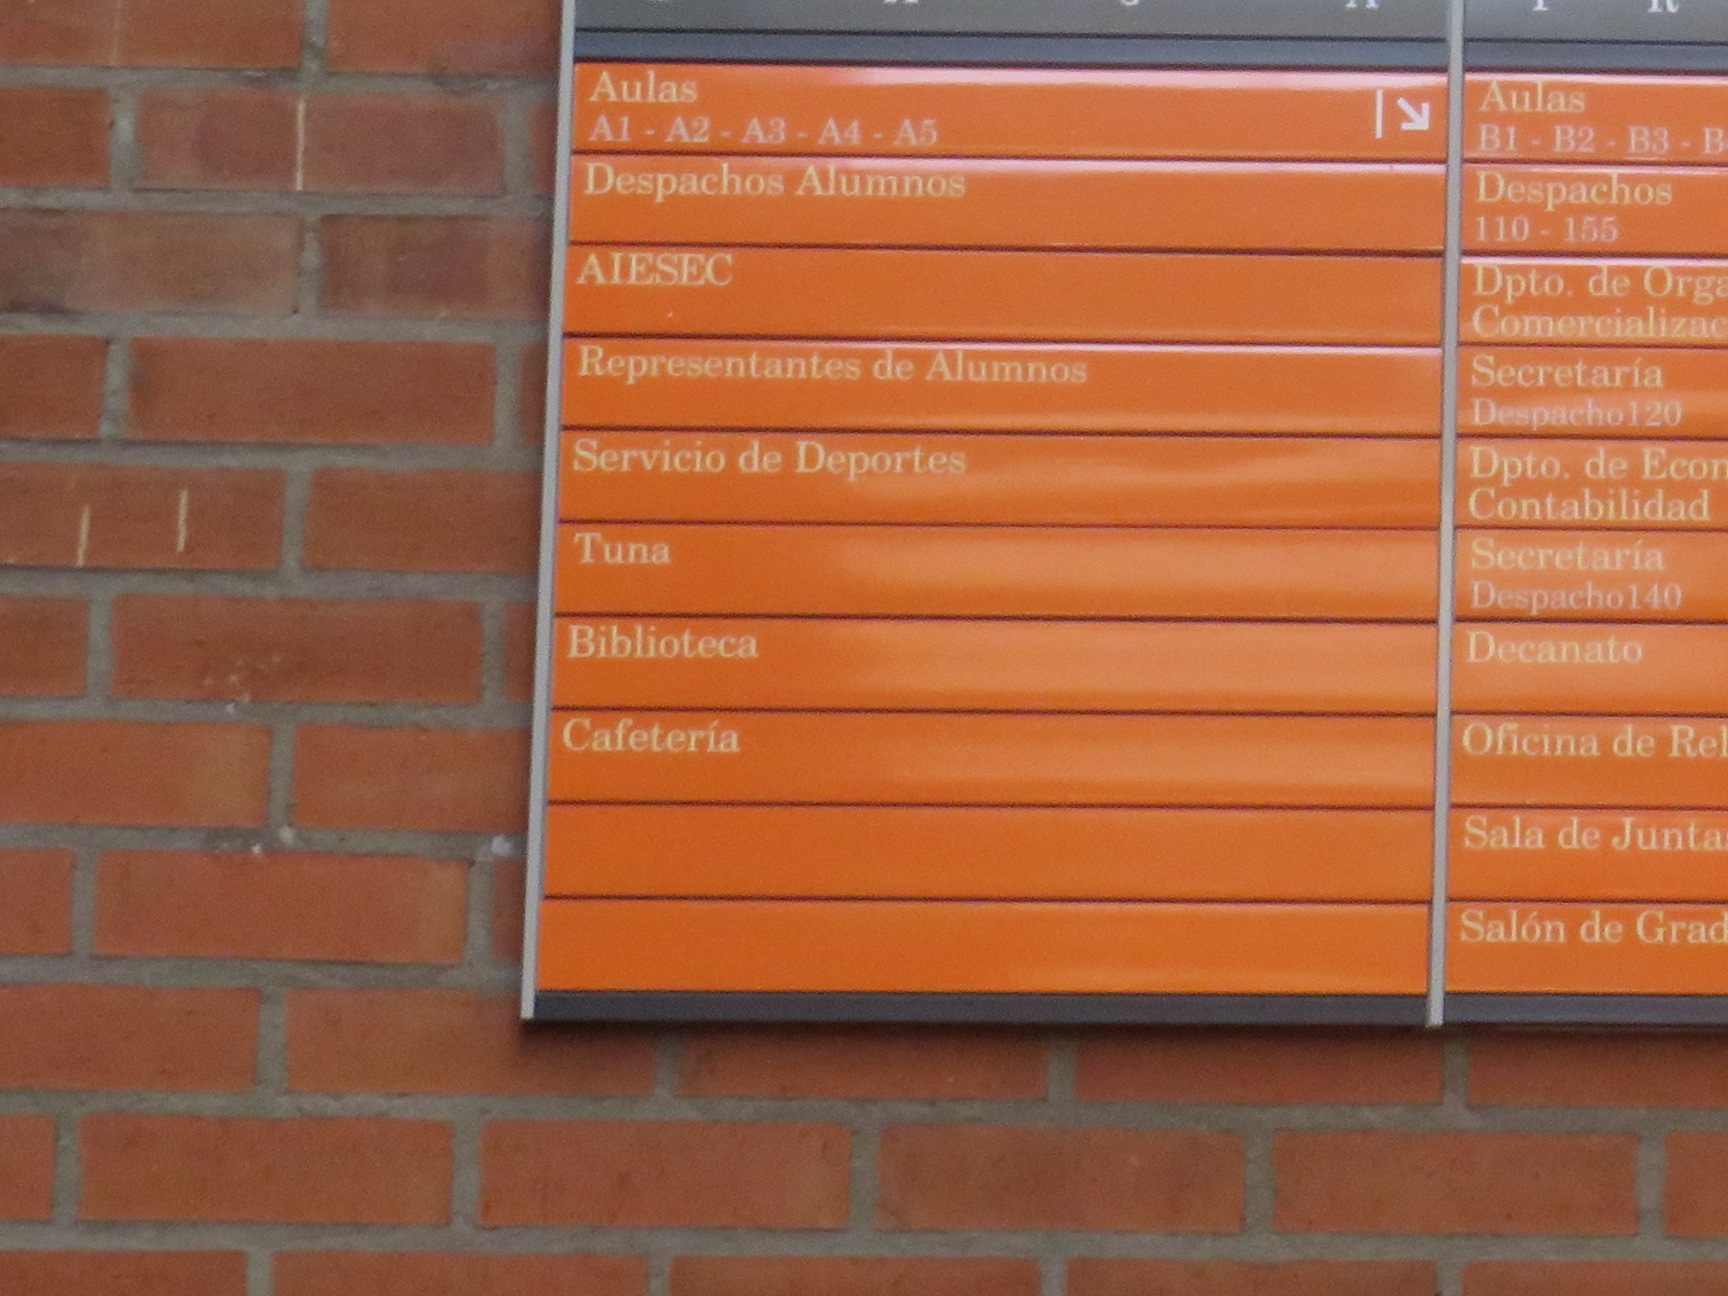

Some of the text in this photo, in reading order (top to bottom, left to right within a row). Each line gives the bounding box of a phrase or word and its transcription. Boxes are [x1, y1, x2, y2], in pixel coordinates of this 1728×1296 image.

[589, 67, 697, 103] Aulas
[1479, 79, 1586, 113] Aulas
[588, 112, 938, 147] A1 A2 A3 A4 A5
[583, 159, 966, 204] Despachos Alumnos
[1476, 172, 1674, 209] Despachos
[576, 252, 733, 287] AIESEC
[1473, 265, 1574, 304] Dpto.
[1588, 266, 1630, 298] de
[578, 345, 1088, 384] Representantes de Alumnos
[1471, 354, 1665, 390] Secretaría
[572, 437, 966, 483] Servicio de Deportes
[1469, 444, 1570, 489] Dpto.
[1582, 445, 1628, 483] de
[1467, 485, 1711, 522] Contabilidad
[573, 531, 670, 565] Tuna
[1470, 535, 1666, 572] Secretaría
[568, 622, 758, 660] Biblioteca
[1466, 627, 1643, 664] Decanato
[561, 716, 741, 753] Cafetería
[1461, 720, 1601, 758] Oficina
[1612, 723, 1656, 758] de
[1463, 813, 1544, 850] Sala
[1557, 816, 1601, 850] de
[1460, 907, 1566, 944] Salón
[1579, 908, 1624, 944] de
